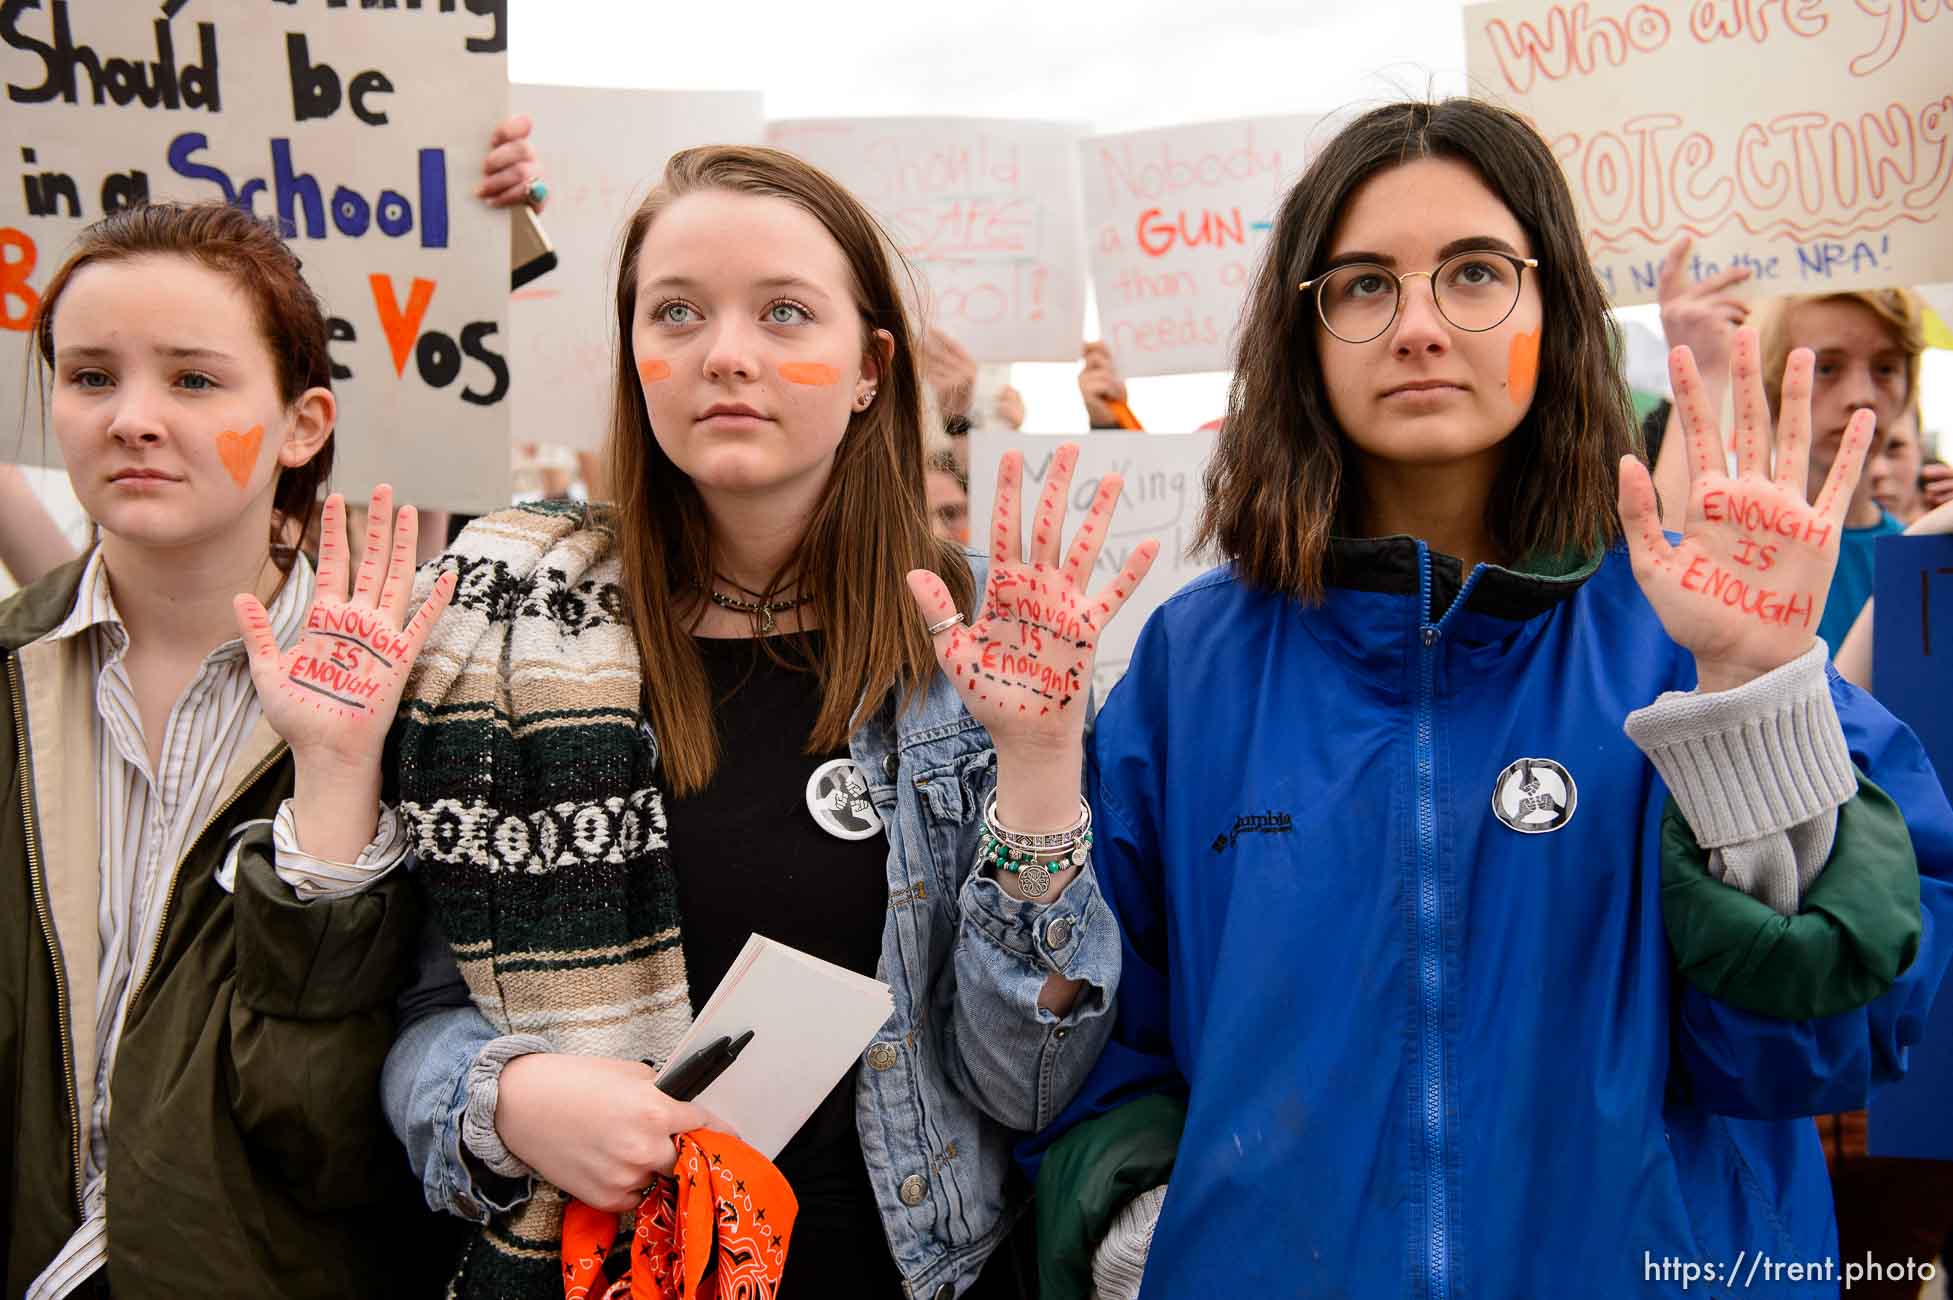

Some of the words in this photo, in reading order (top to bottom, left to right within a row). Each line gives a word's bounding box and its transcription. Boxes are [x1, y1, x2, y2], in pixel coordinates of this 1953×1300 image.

[0, 0, 221, 112] Should
[286, 33, 395, 125] be
[1485, 3, 1671, 95] Who
[22, 147, 82, 217] in
[101, 170, 150, 215] a
[168, 132, 449, 249] School
[1702, 490, 1832, 549] ENOUGH
[1732, 537, 1777, 571] IS
[1680, 556, 1814, 628] ENOUGH
[307, 607, 409, 660] ENOUGH
[331, 641, 362, 669] IS
[289, 655, 380, 698] ENOUGH
